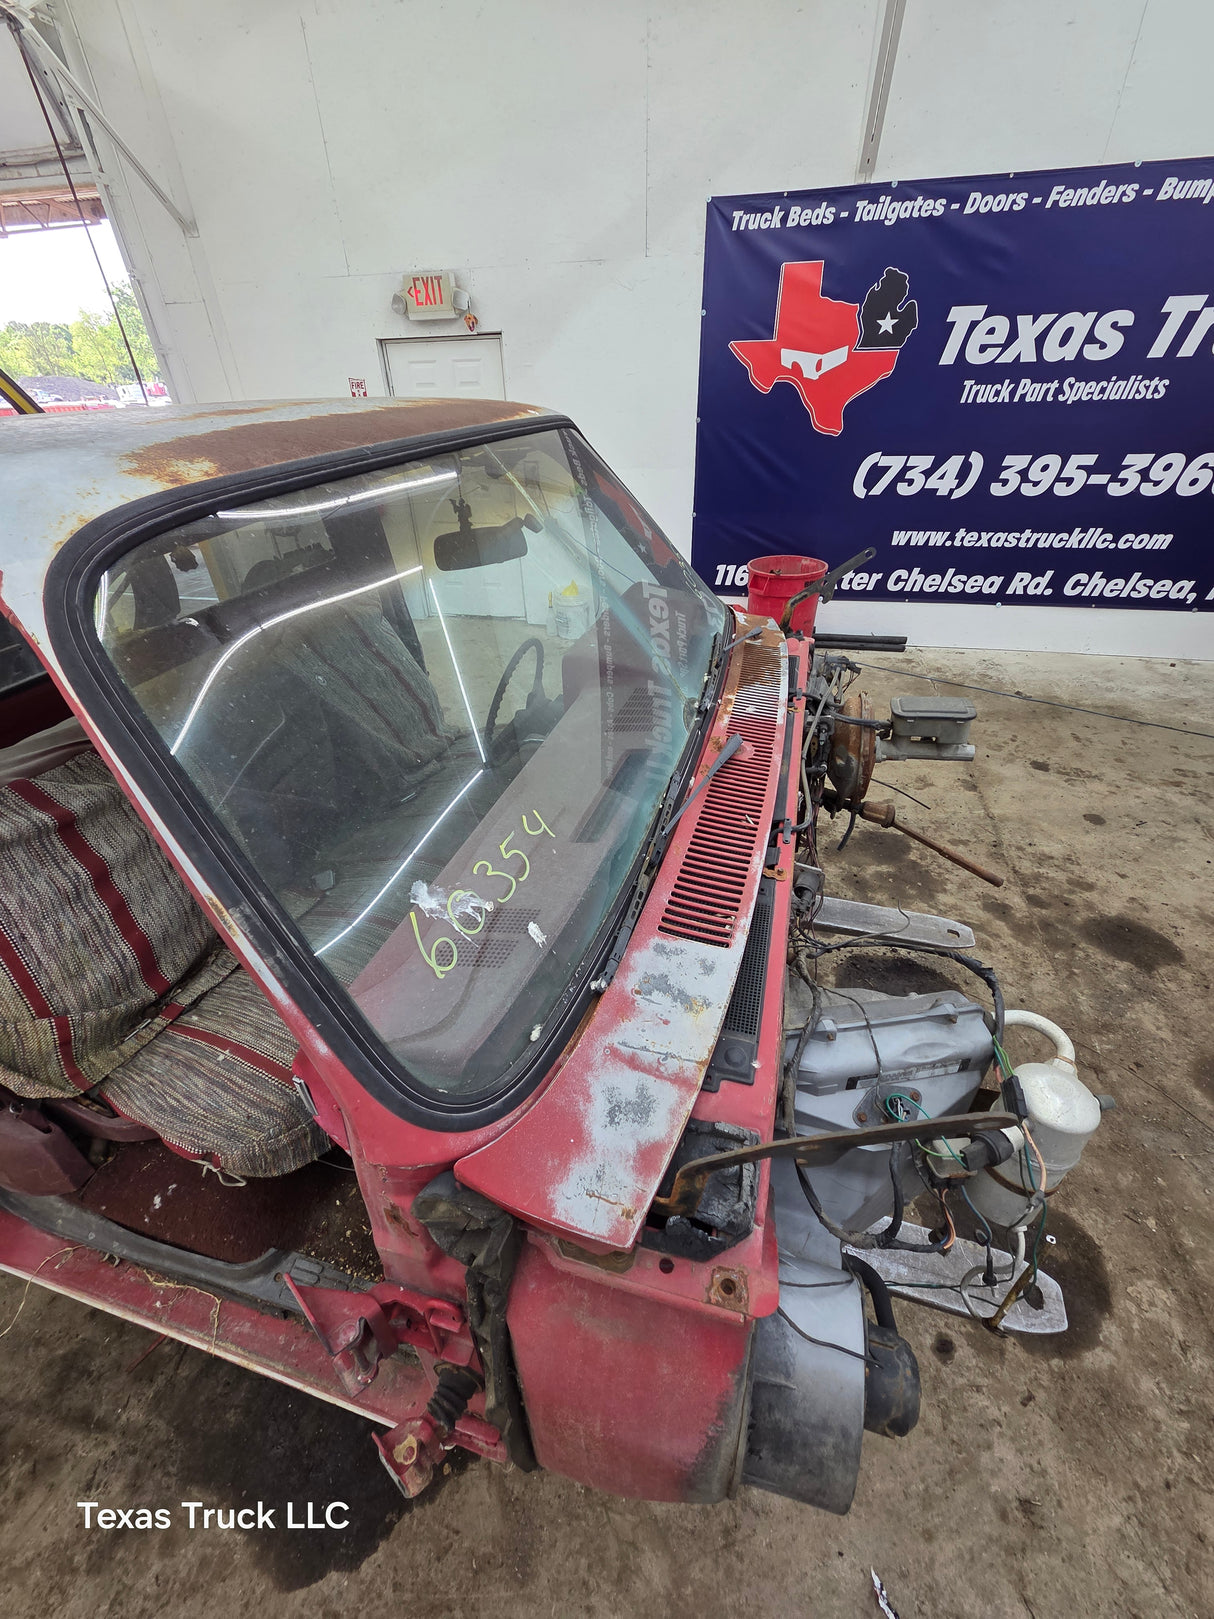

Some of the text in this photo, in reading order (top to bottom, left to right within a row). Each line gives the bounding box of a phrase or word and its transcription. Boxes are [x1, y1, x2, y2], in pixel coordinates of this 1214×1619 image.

[732, 206, 784, 231] Truck
[786, 202, 835, 228] Beds
[854, 195, 947, 226] Tailgates
[964, 191, 1028, 215] Doors
[1044, 179, 1139, 208] Fenders
[412, 275, 444, 307] EXIT
[939, 294, 1214, 366] Texas Tr
[351, 381, 365, 390] FIRE
[959, 374, 1170, 405] Truck Part Specialists
[852, 450, 1214, 500] (734) 395-396
[891, 527, 1174, 550] www.texastruckllc.com
[886, 567, 1004, 594] Chelsea
[1005, 570, 1054, 596] Rd.
[1063, 571, 1197, 604] Chelsea,
[409, 809, 556, 980] 60354
